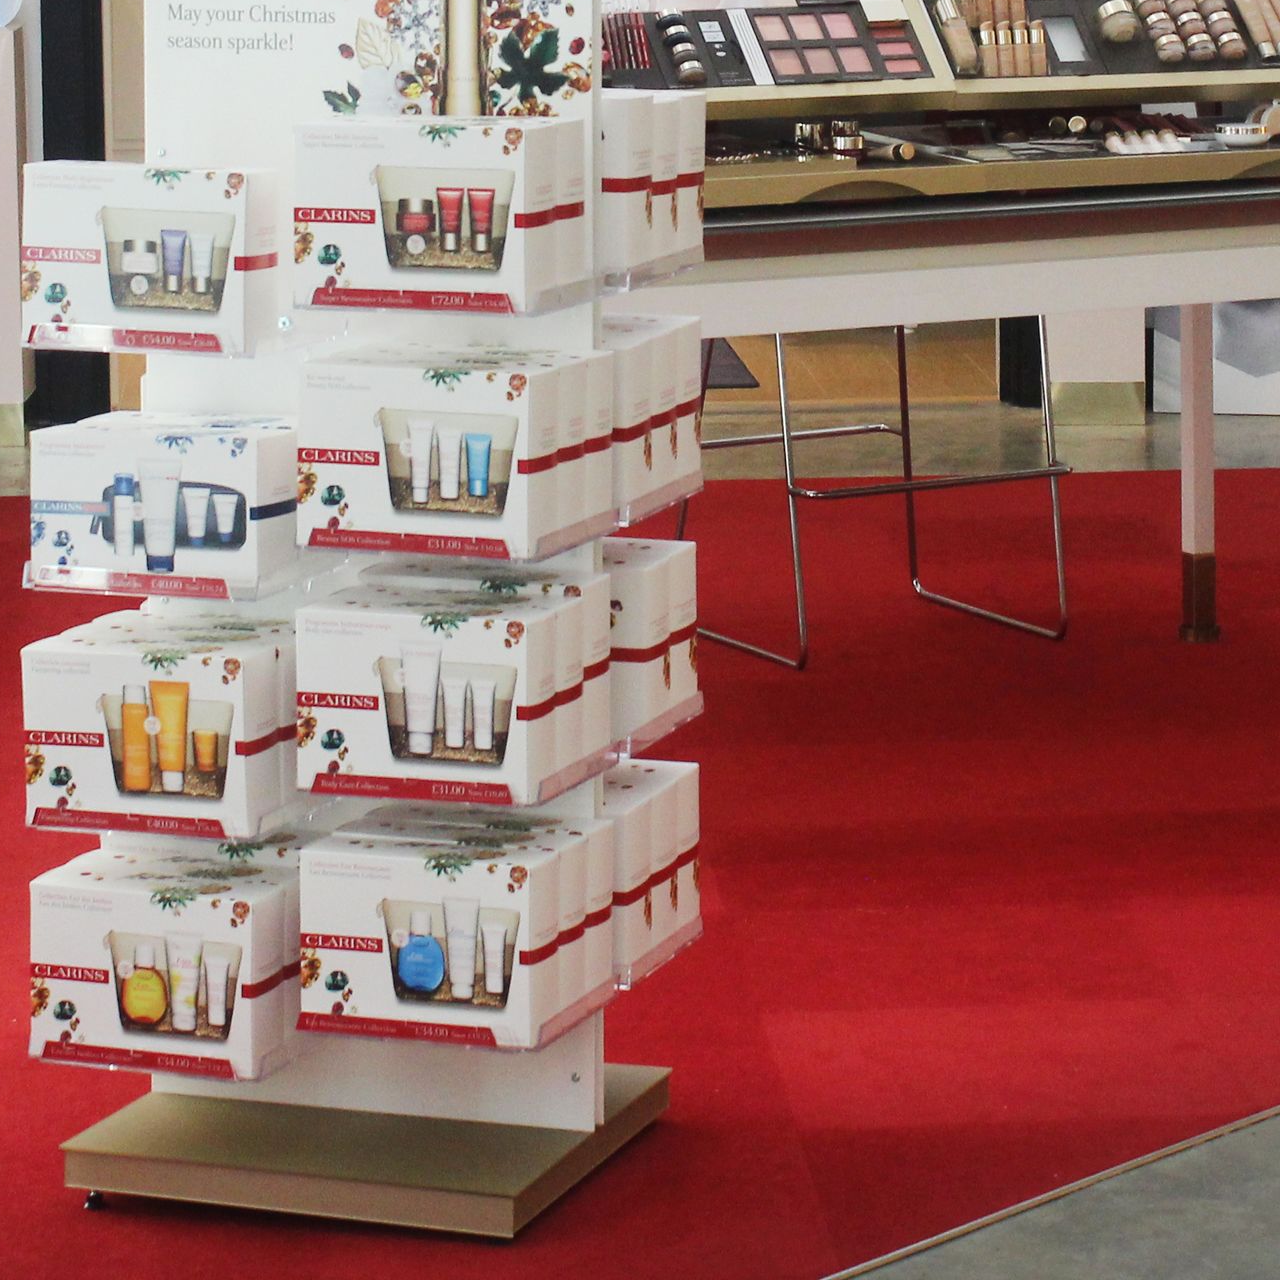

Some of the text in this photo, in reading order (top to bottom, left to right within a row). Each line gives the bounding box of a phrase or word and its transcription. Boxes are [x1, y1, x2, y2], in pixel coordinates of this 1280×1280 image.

[168, 3, 336, 27] May your Christmas
[168, 31, 294, 54] season sparkle!
[298, 208, 371, 221] CLARINS
[26, 247, 96, 261] CLARINS
[431, 295, 463, 306] £72.00
[301, 450, 375, 463] CLARINS
[301, 694, 374, 708] CLARINS
[29, 732, 100, 745] CLARINS
[432, 784, 465, 796] £31.00
[305, 935, 378, 951] CLARINS
[34, 965, 104, 981] CLARINS
